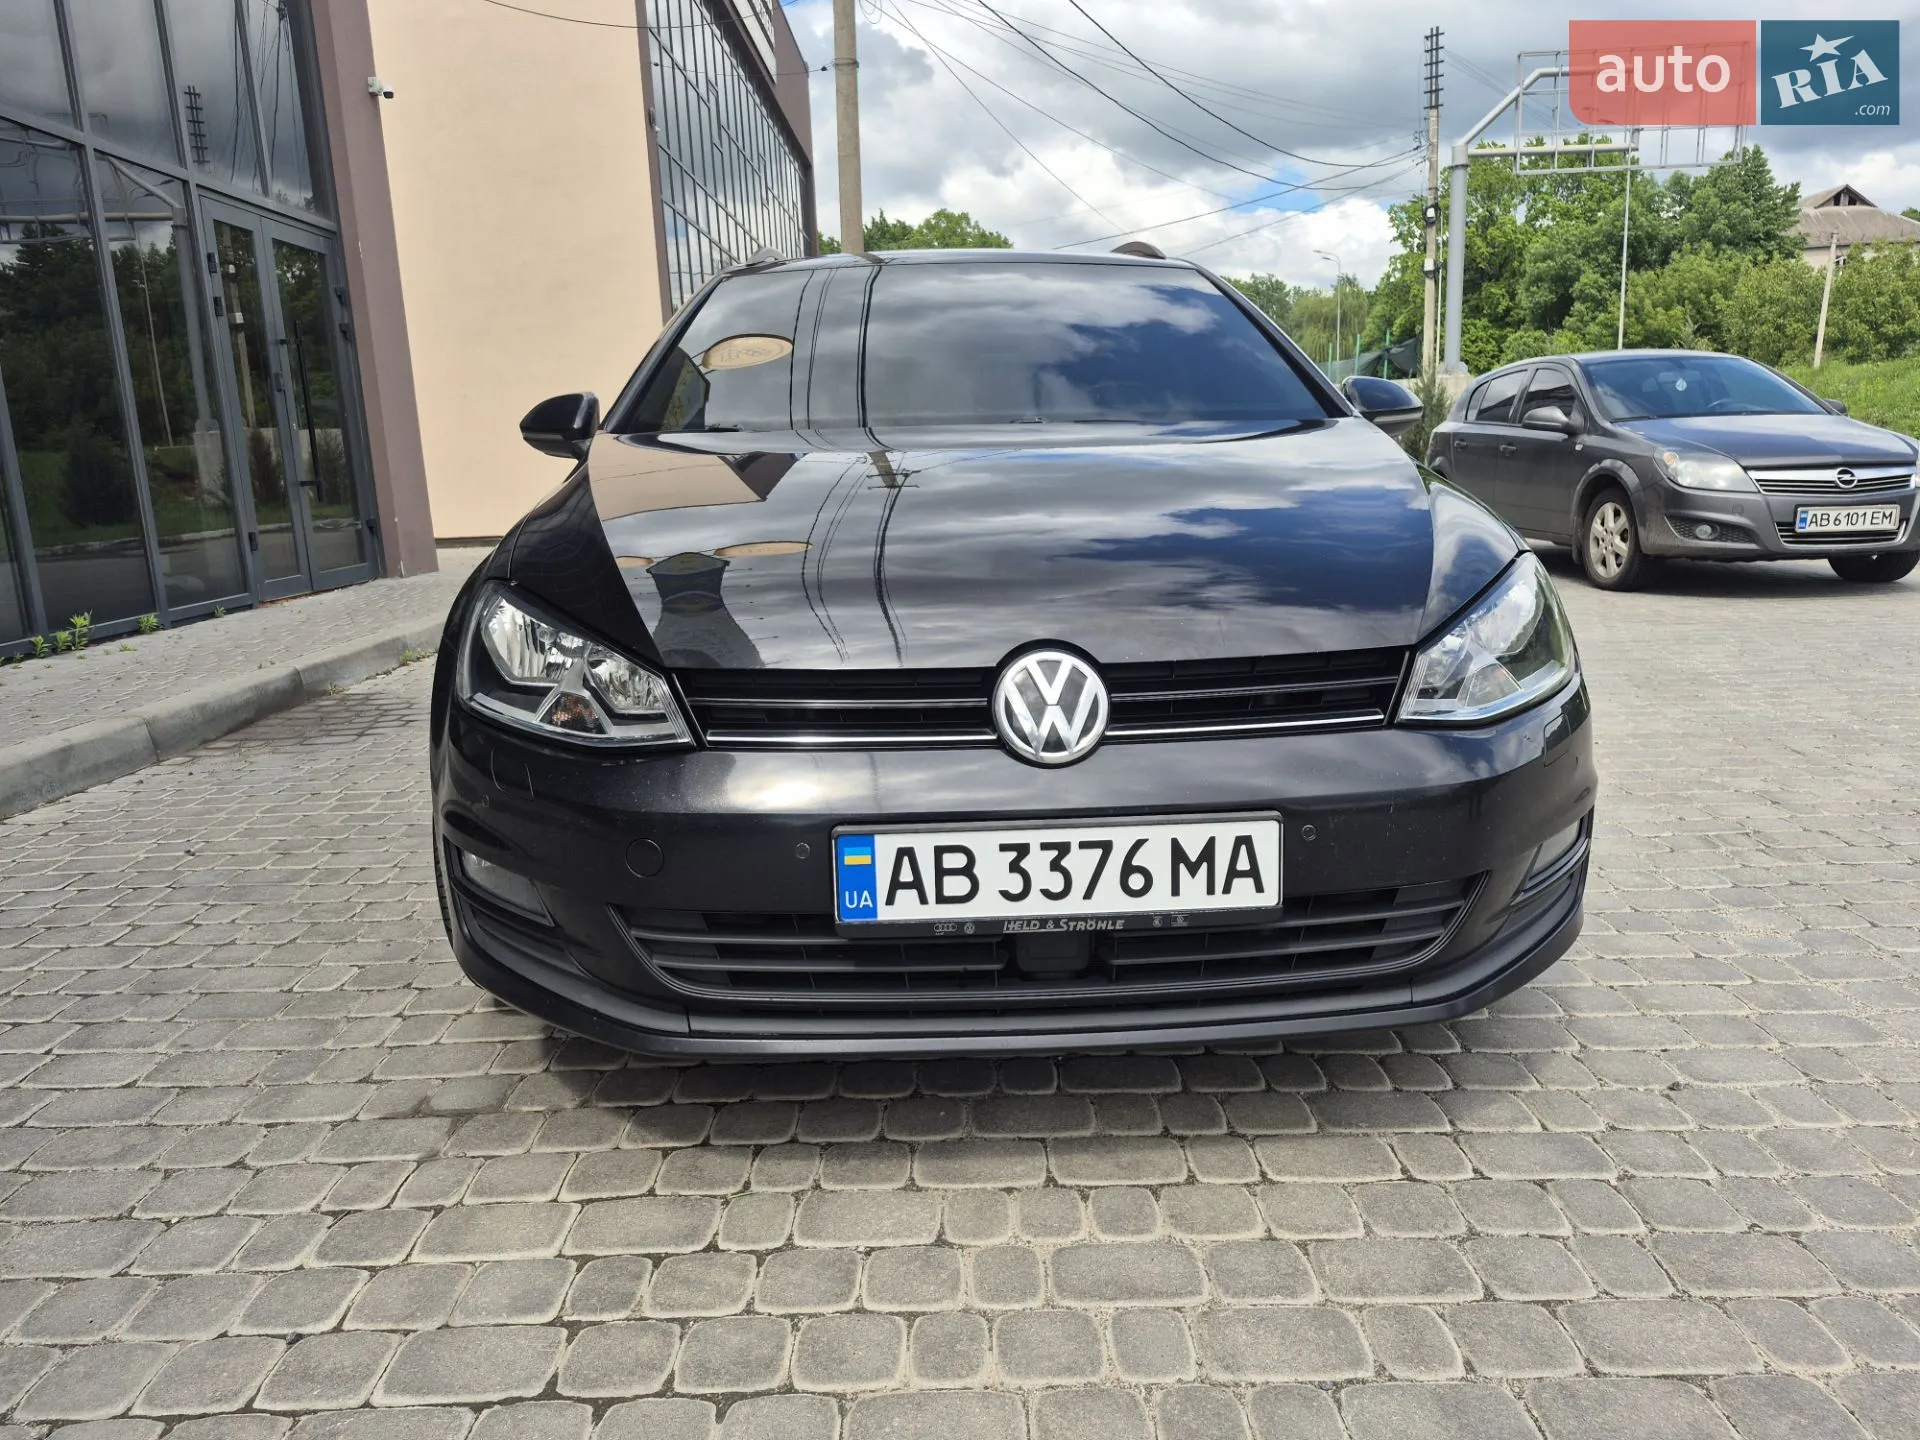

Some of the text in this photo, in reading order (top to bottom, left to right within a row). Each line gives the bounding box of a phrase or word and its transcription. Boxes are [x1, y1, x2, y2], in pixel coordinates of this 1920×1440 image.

[1808, 512, 1831, 528] AB
[1833, 511, 1867, 527] 6101
[1870, 510, 1893, 526] EM
[884, 834, 1265, 906] AB 3376 MA
[845, 890, 873, 909] UA
